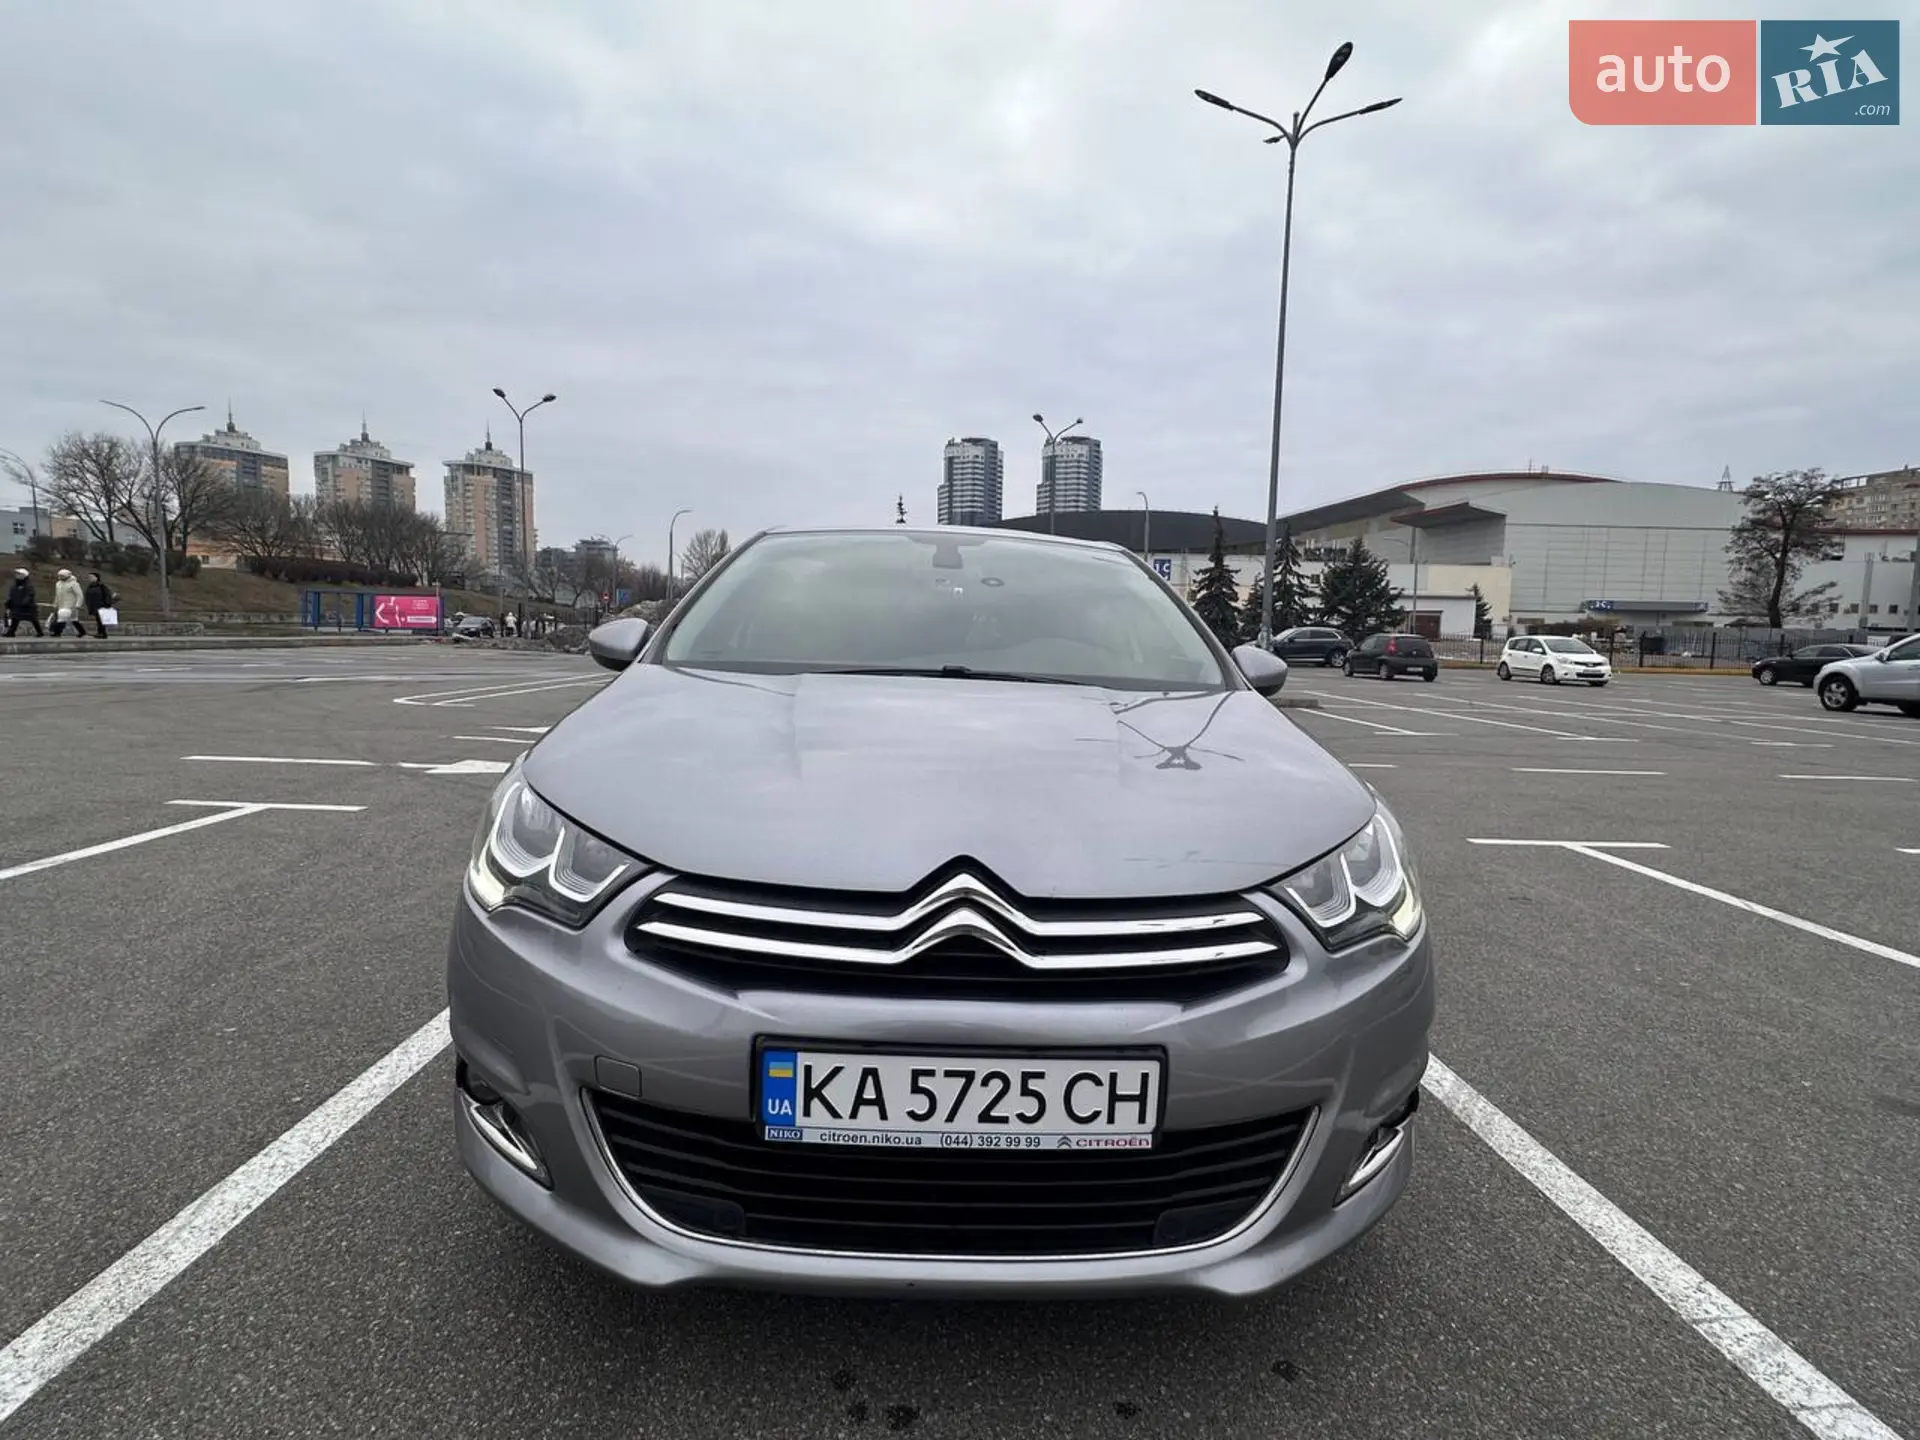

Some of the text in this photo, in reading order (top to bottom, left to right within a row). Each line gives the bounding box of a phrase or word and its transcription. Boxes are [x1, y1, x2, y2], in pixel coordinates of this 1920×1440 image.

[803, 1064, 1150, 1124] KA 5725 CH
[768, 1099, 792, 1116] UA
[769, 1128, 801, 1139] NIKO
[820, 1131, 1041, 1148] citroen.niko.ua (044) 392 99 99
